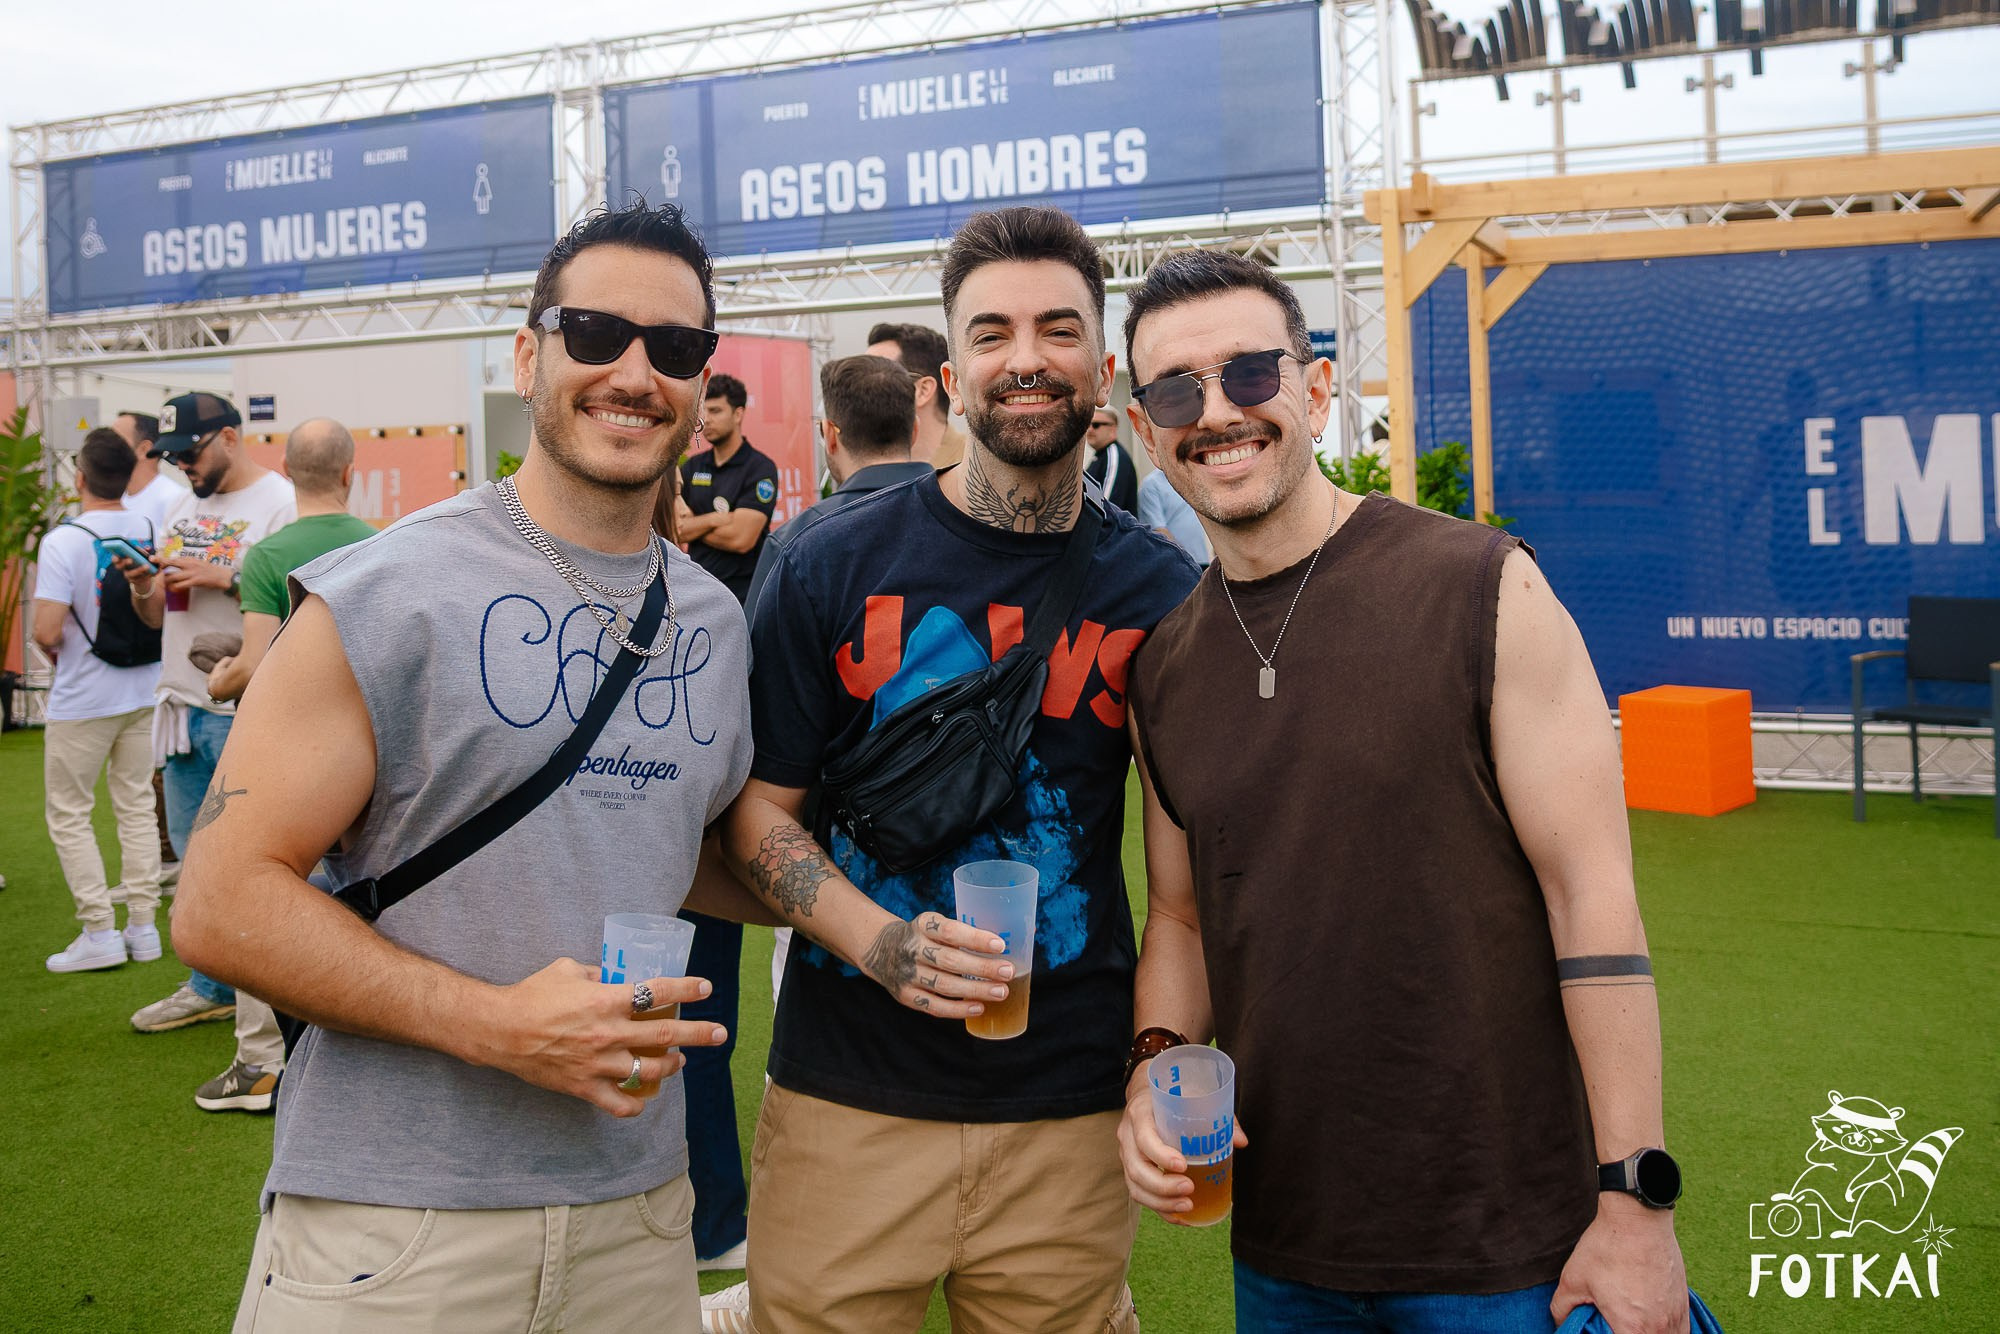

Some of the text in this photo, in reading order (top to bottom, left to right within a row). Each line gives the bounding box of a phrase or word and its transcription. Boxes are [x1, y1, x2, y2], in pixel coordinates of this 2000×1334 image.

[871, 70, 986, 119] MUELLE
[1053, 64, 1115, 87] ALICANTE
[764, 102, 809, 122] PUERTO
[234, 152, 317, 190] MUELLE
[741, 127, 1148, 222] ASEOS HOMBRES
[143, 200, 427, 277] ASEOS MUJERES
[1861, 412, 2000, 545] M
[1667, 616, 1910, 640] UN NUEVO ESPACIO CUL
[550, 739, 681, 790] penhagen
[580, 789, 647, 801] WHERE EVERY CORNER
